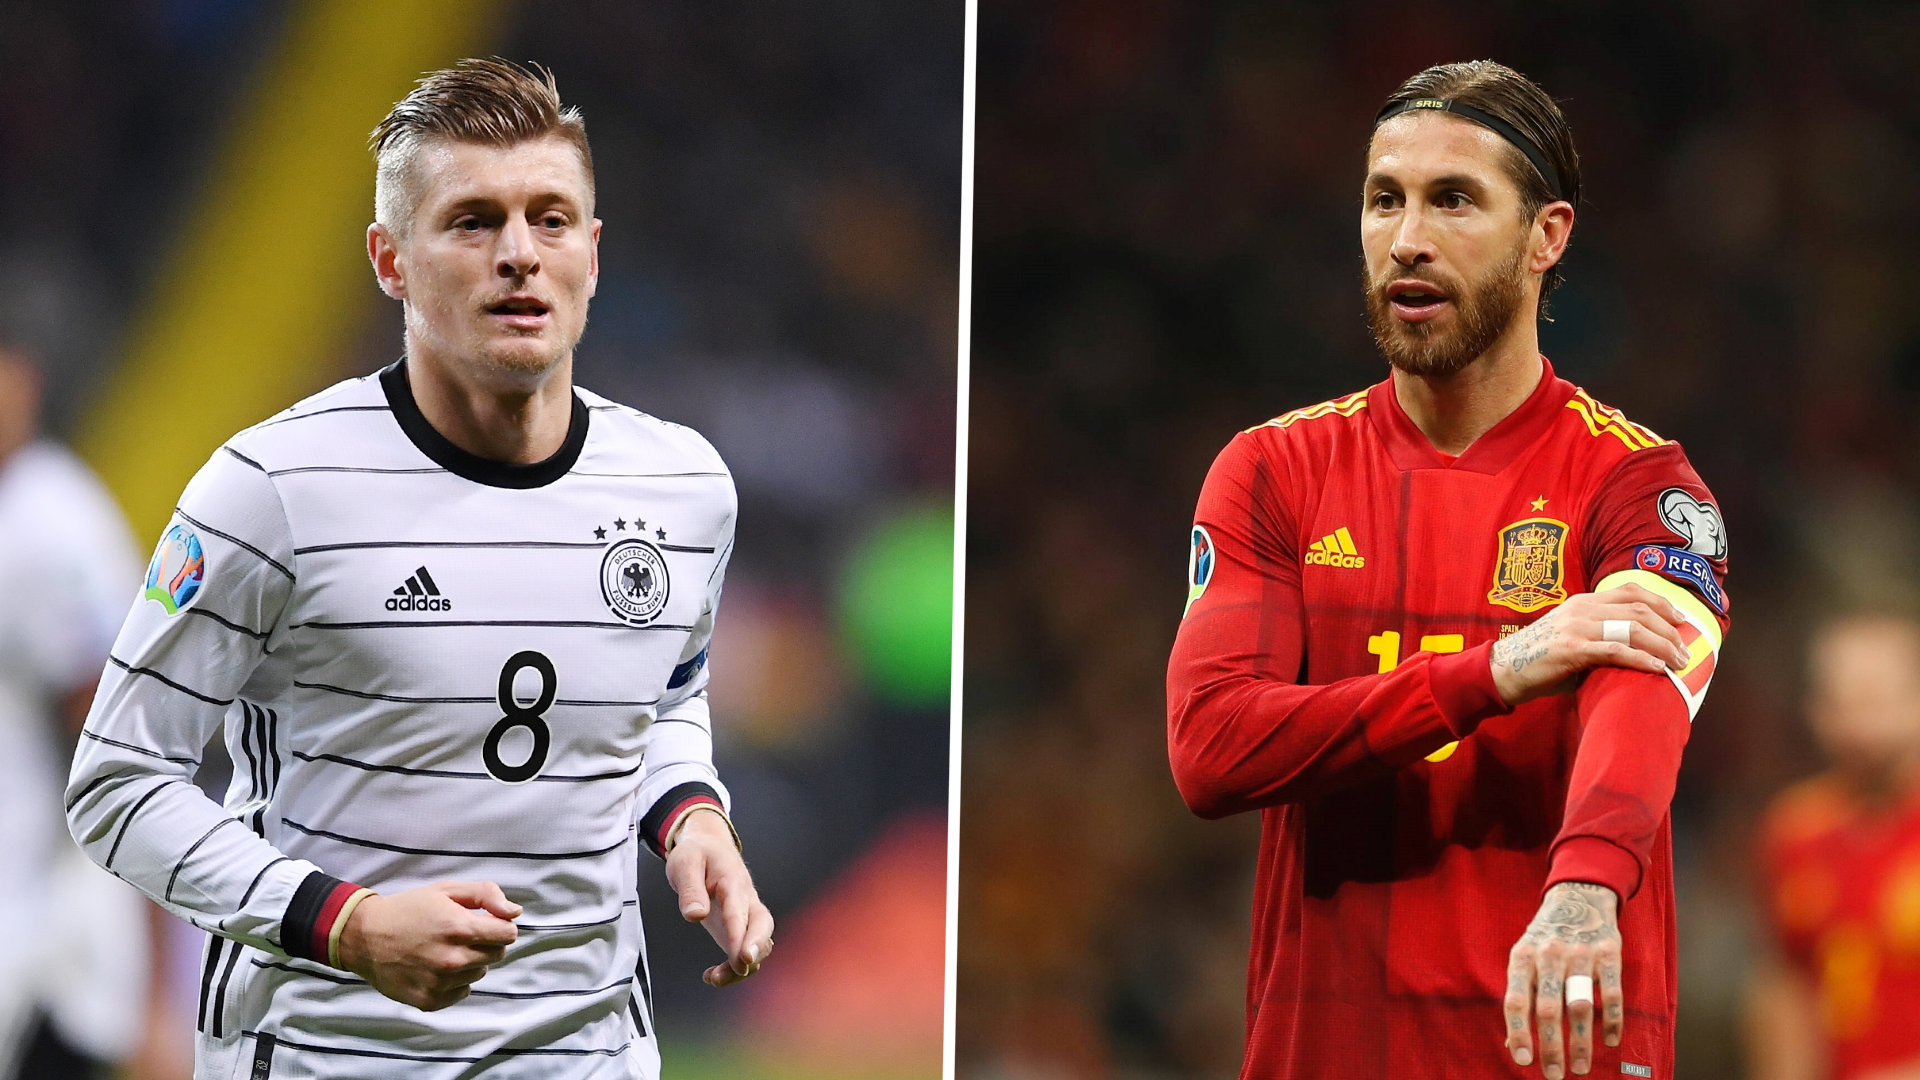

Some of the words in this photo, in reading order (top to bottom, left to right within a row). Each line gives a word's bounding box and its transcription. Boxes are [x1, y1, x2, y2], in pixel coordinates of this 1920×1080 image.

[614, 549, 656, 565] DEUTSCHER
[1304, 549, 1366, 569] adidas
[1643, 548, 1661, 557] UEFA
[1668, 555, 1722, 605] RESPECT
[384, 594, 452, 612] adidas
[1501, 624, 1519, 633] SPAIN
[481, 649, 558, 784] 8
